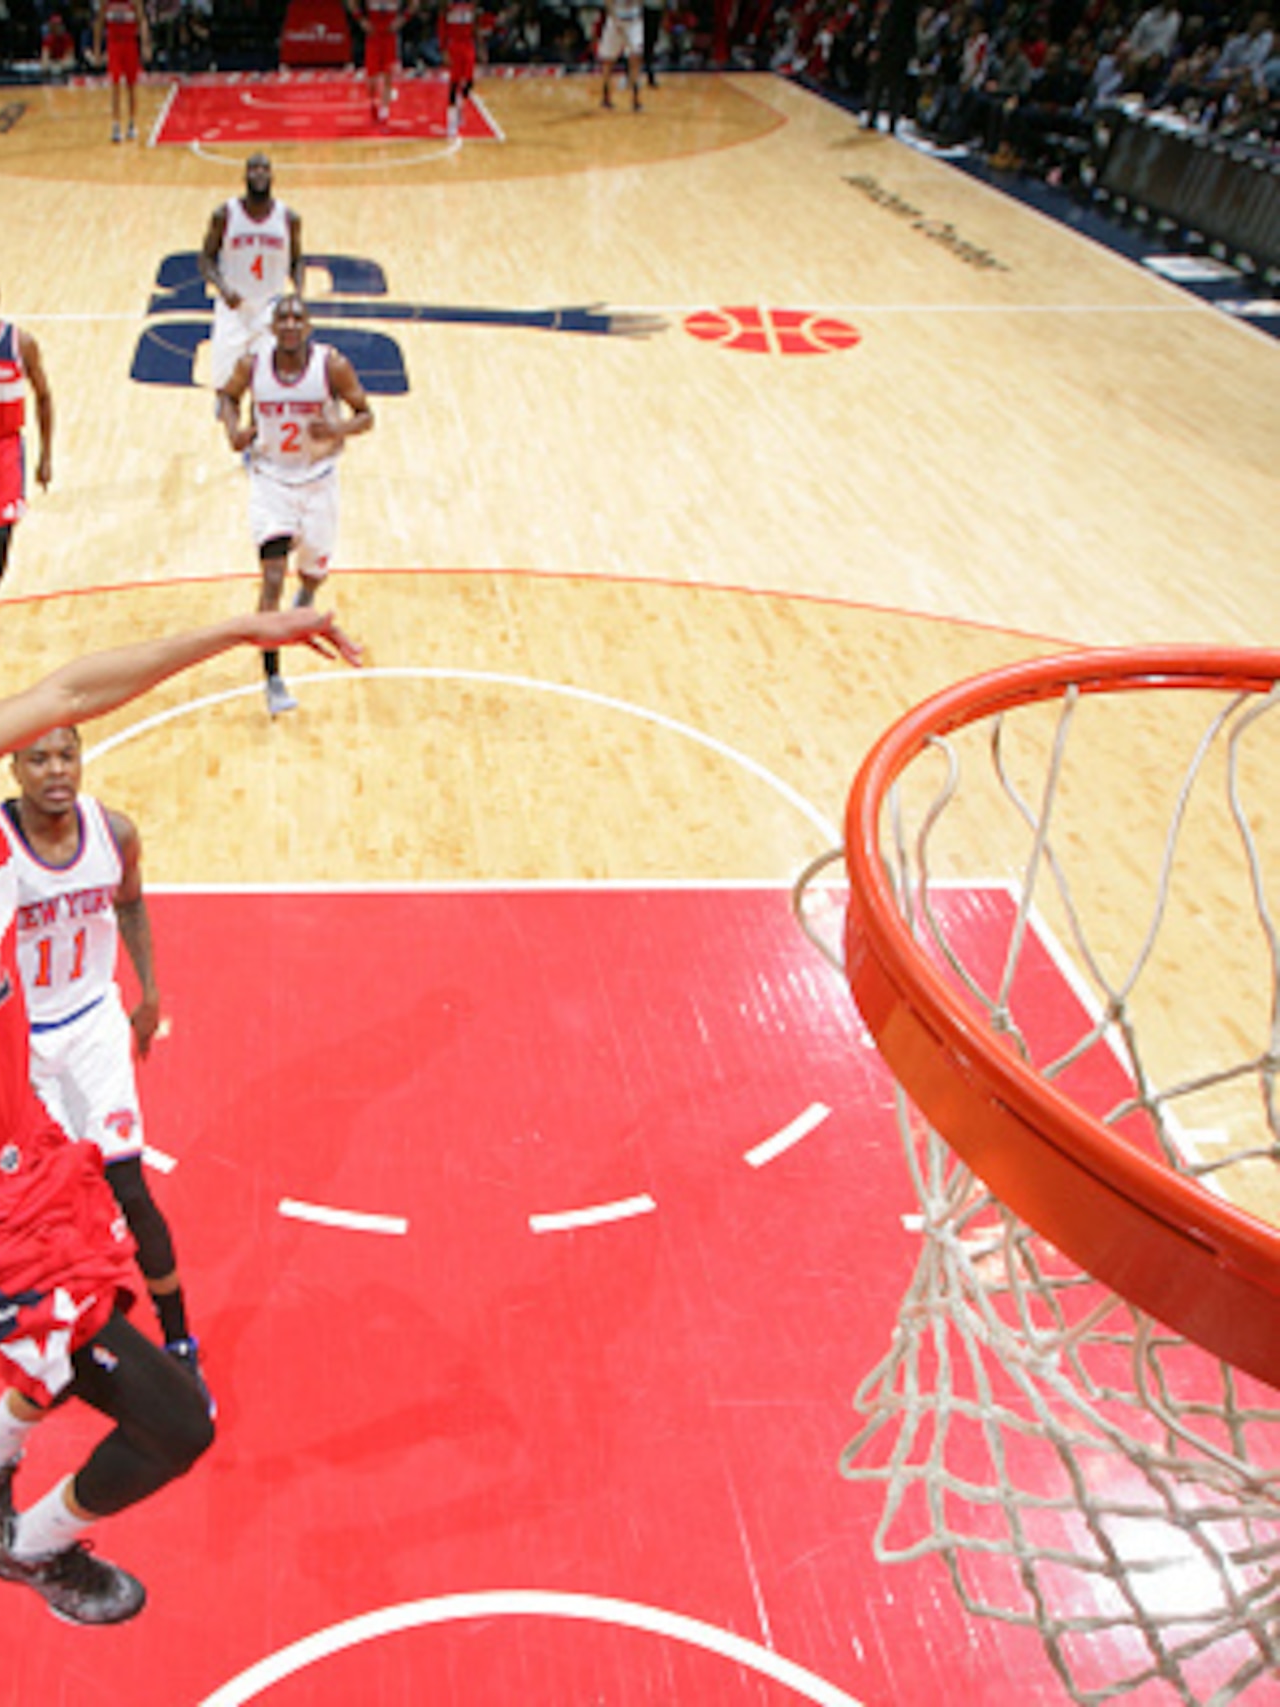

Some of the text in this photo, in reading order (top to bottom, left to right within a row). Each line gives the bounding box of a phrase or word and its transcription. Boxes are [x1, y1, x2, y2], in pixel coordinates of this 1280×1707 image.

[249, 254, 264, 282] 4
[279, 421, 302, 453] 2
[17, 897, 61, 931] EW
[32, 924, 87, 988] 11
